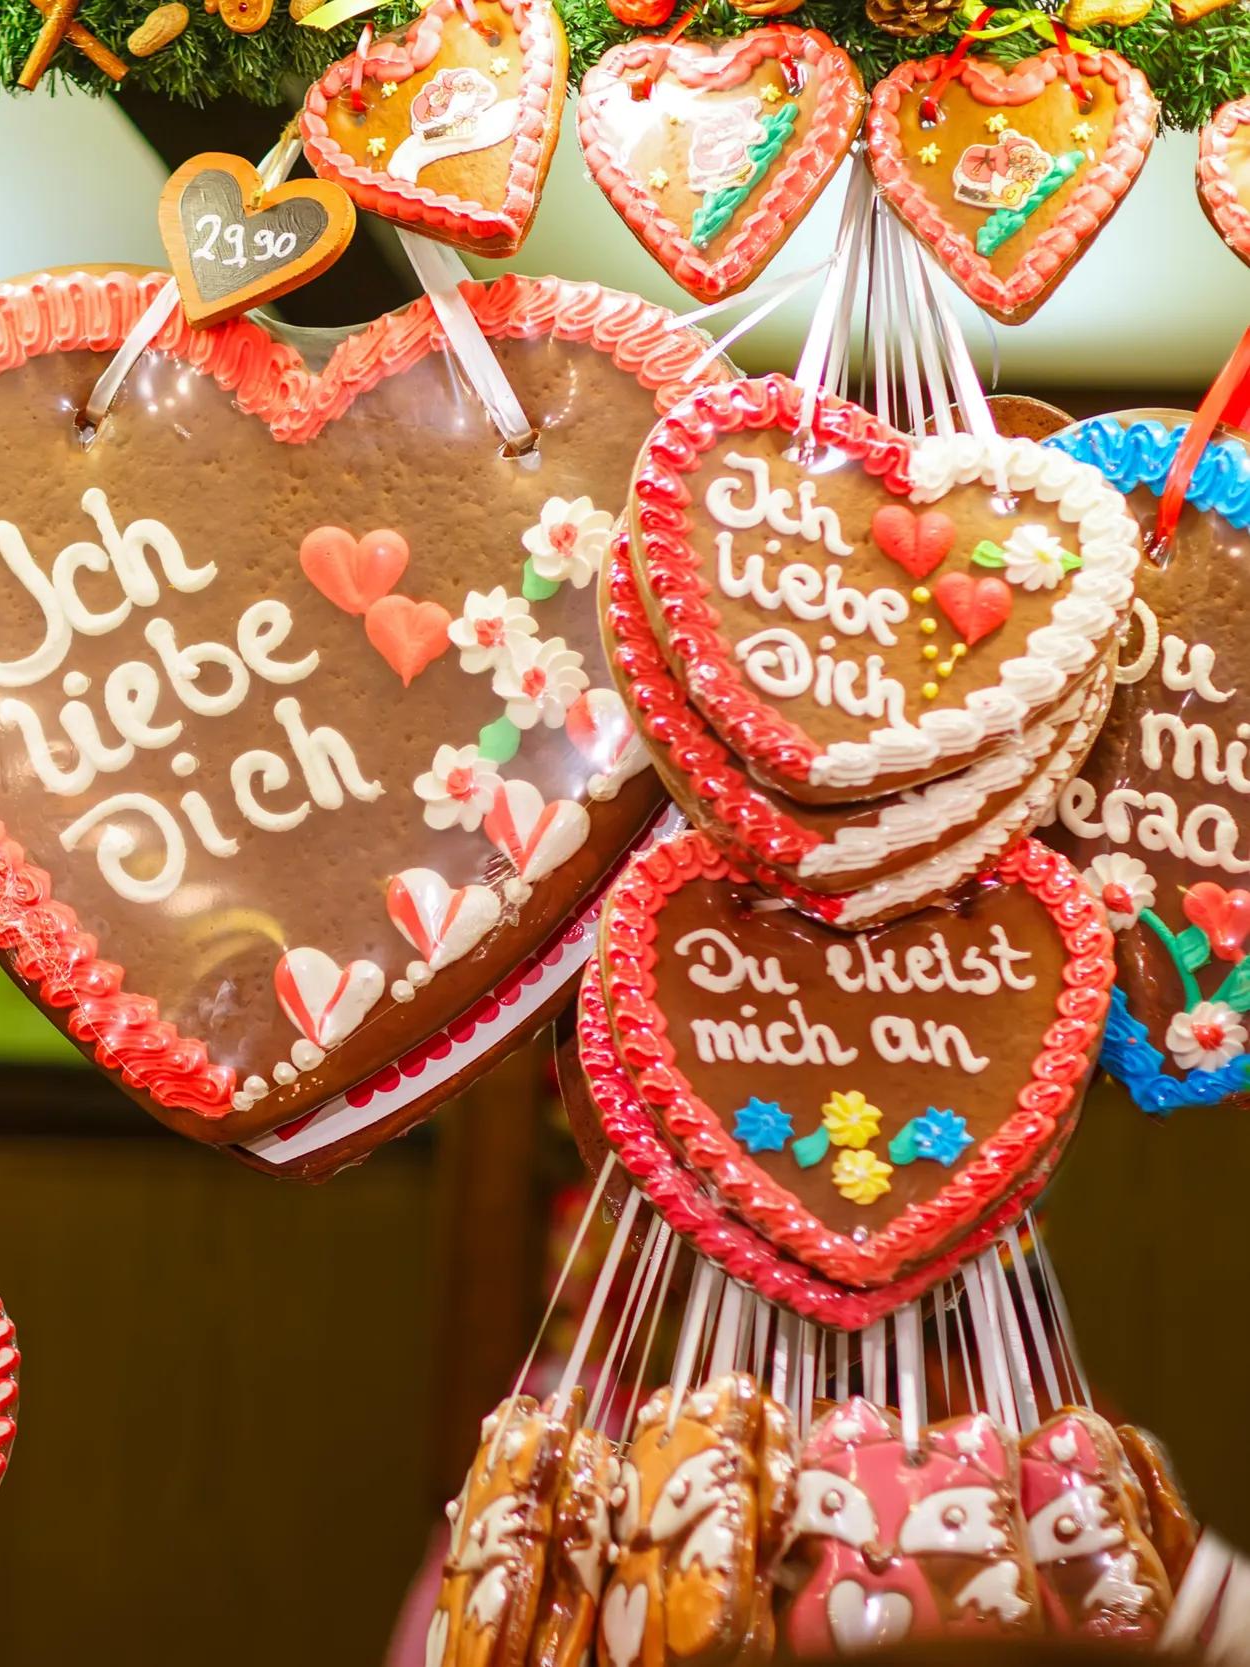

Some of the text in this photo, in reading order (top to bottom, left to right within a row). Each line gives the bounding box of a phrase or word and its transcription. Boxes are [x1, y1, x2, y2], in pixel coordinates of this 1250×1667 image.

[705, 451, 854, 556] Ich
[715, 531, 909, 646] liebe
[1, 600, 319, 796] liebe
[735, 628, 913, 730] Dich
[60, 698, 386, 903] Dich
[674, 924, 1036, 995] Du ekelst
[690, 999, 990, 1074] mich an
